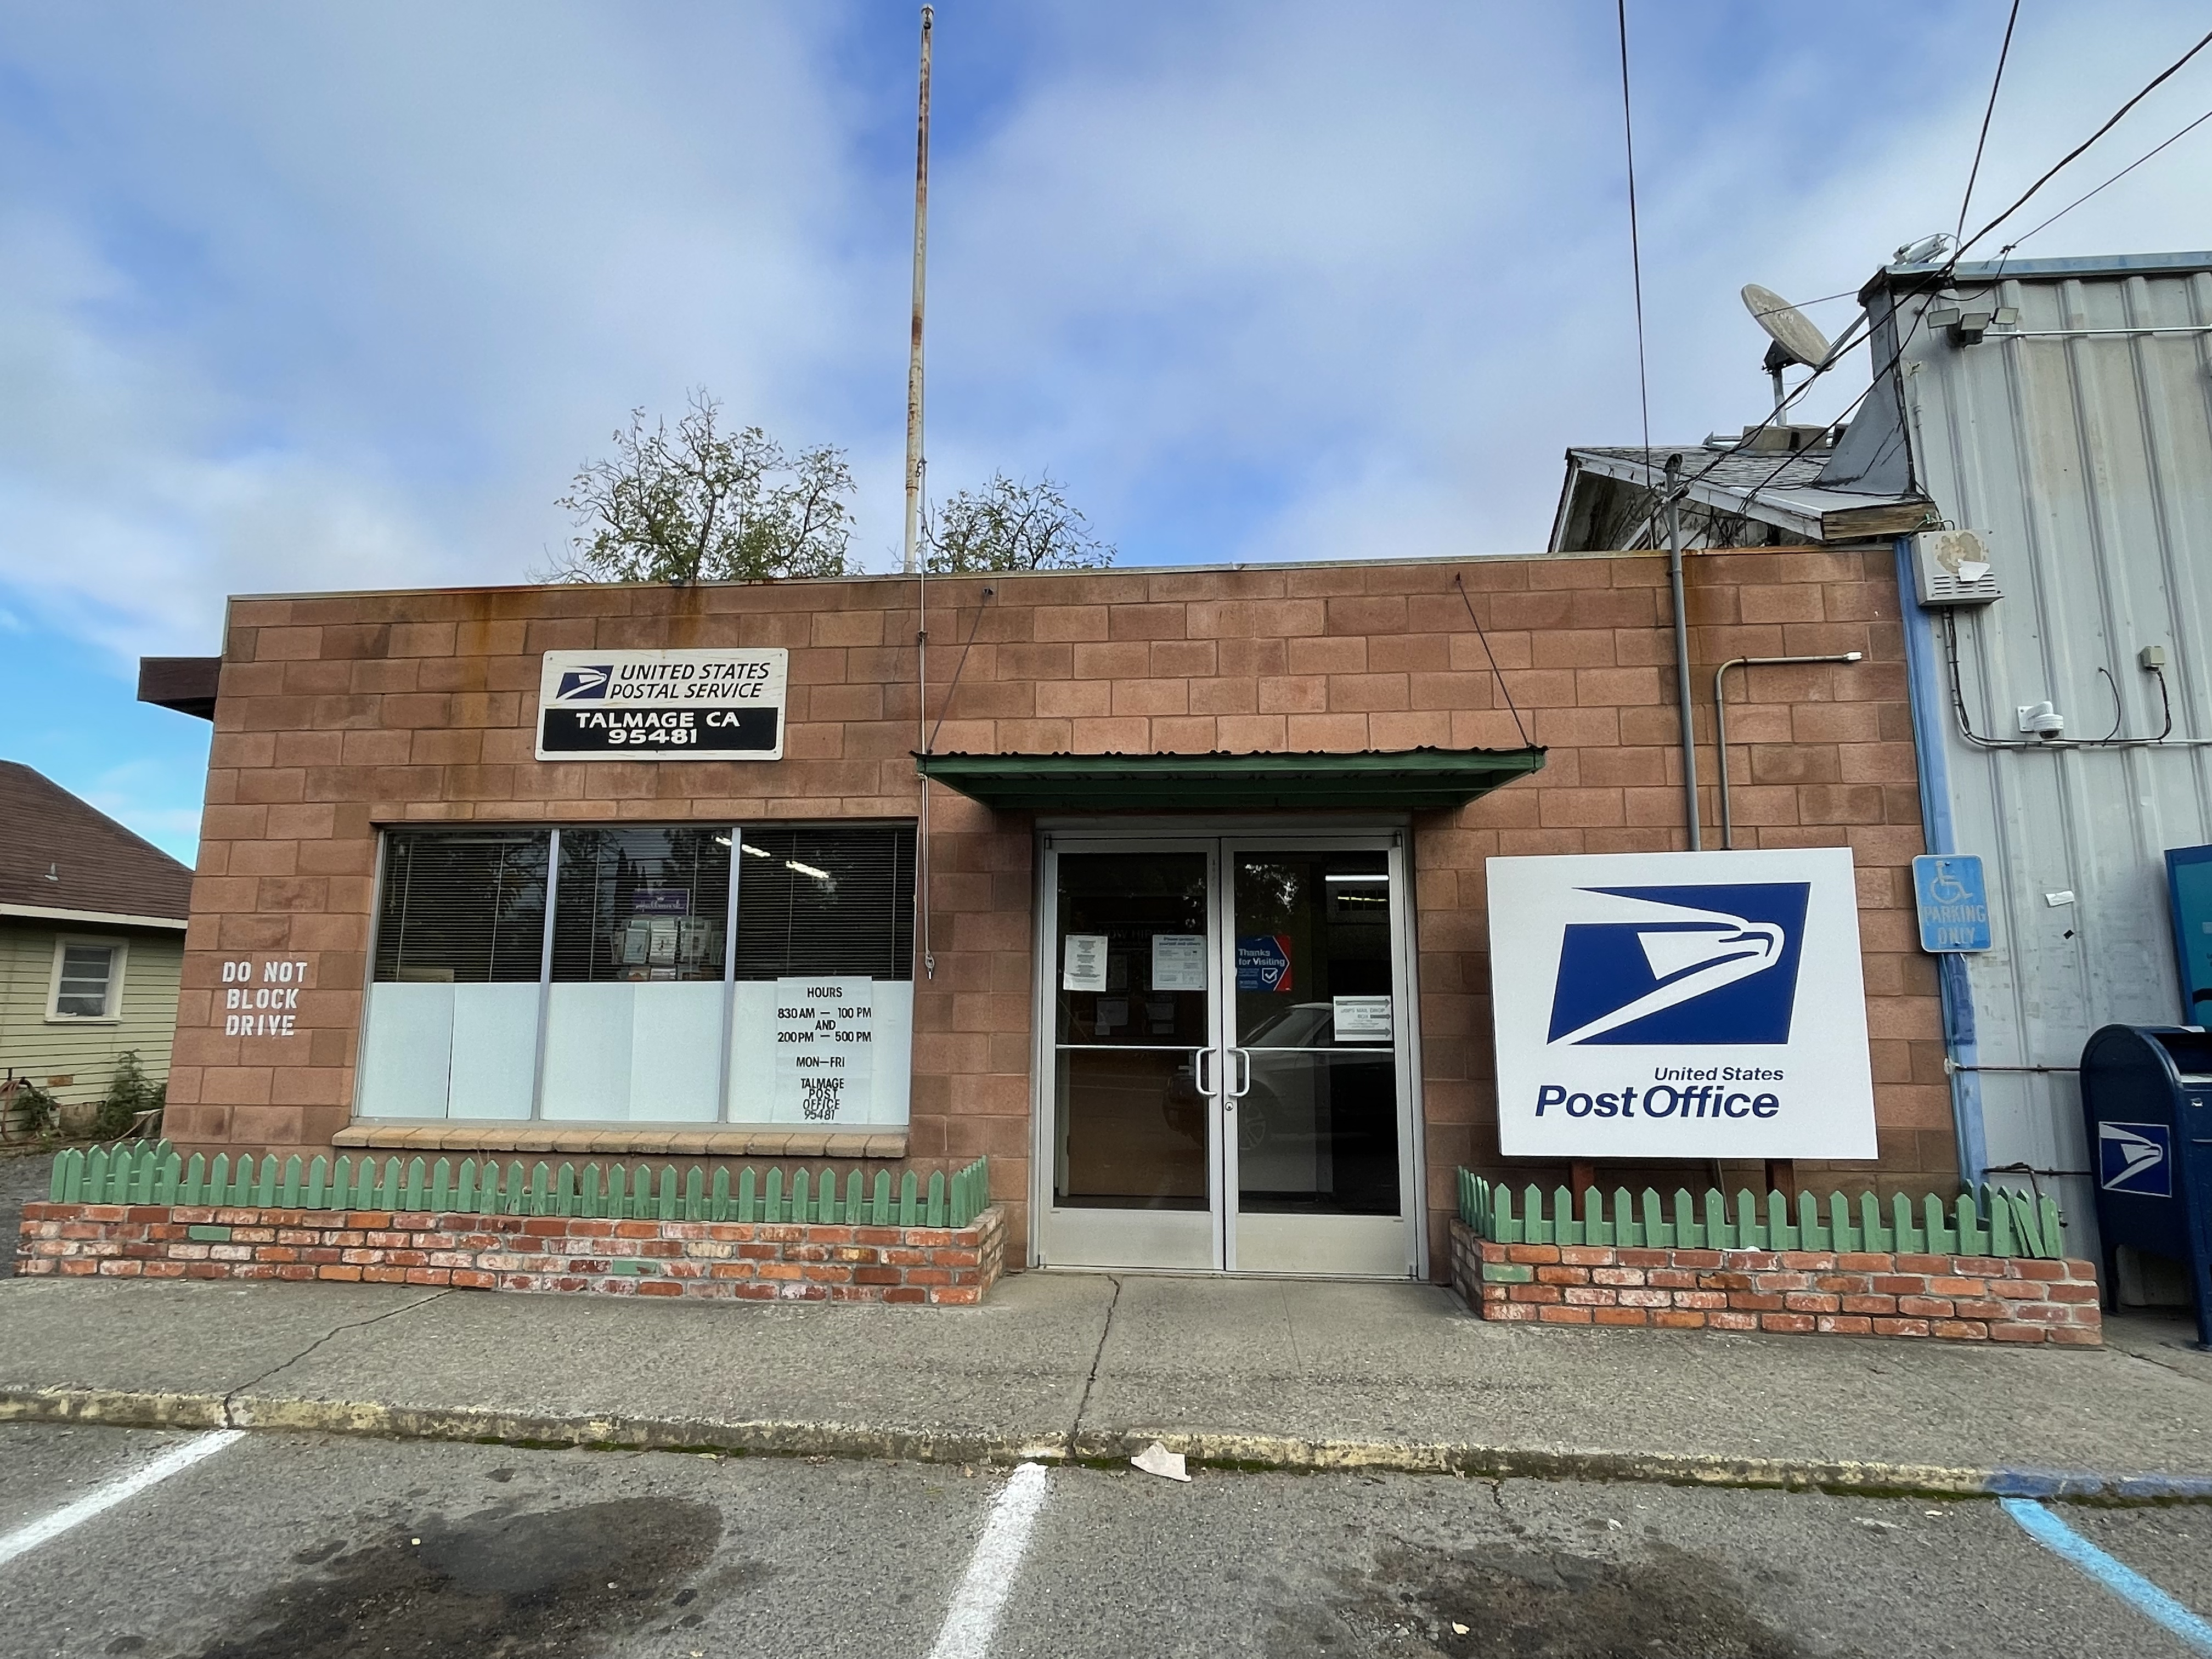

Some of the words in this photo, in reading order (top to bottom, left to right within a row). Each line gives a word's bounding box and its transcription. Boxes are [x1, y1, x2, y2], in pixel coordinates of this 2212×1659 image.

[620, 664, 695, 681] UNITED
[698, 662, 770, 680] STATES
[610, 684, 679, 699] POSTAL
[684, 682, 764, 699] SERVICE
[575, 712, 695, 729] TALMAGE
[706, 712, 740, 728] CA
[608, 729, 697, 744] 95481
[1923, 905, 1986, 923] PARKING
[1938, 927, 1975, 945] ONLY
[1238, 948, 1270, 957] Thanks
[1253, 957, 1285, 967] Visiting
[222, 961, 251, 982] DO
[263, 961, 308, 983] NOT
[226, 989, 300, 1009] BLOCK
[807, 987, 843, 998] HOURS
[838, 1007, 854, 1018] 100
[857, 1007, 871, 1018] PM
[225, 1014, 296, 1036] DRIVE
[815, 1020, 836, 1030] AND
[836, 1031, 854, 1042] 500
[856, 1031, 871, 1042] PM
[1655, 1066, 1717, 1081] United
[1722, 1067, 1784, 1081] States
[801, 1078, 844, 1089] TALMAGE
[809, 1088, 838, 1099] POST
[803, 1099, 840, 1110] OFFICE
[1536, 1085, 1638, 1118] Post
[1643, 1085, 1779, 1118] Office
[804, 1110, 835, 1120] 95481
